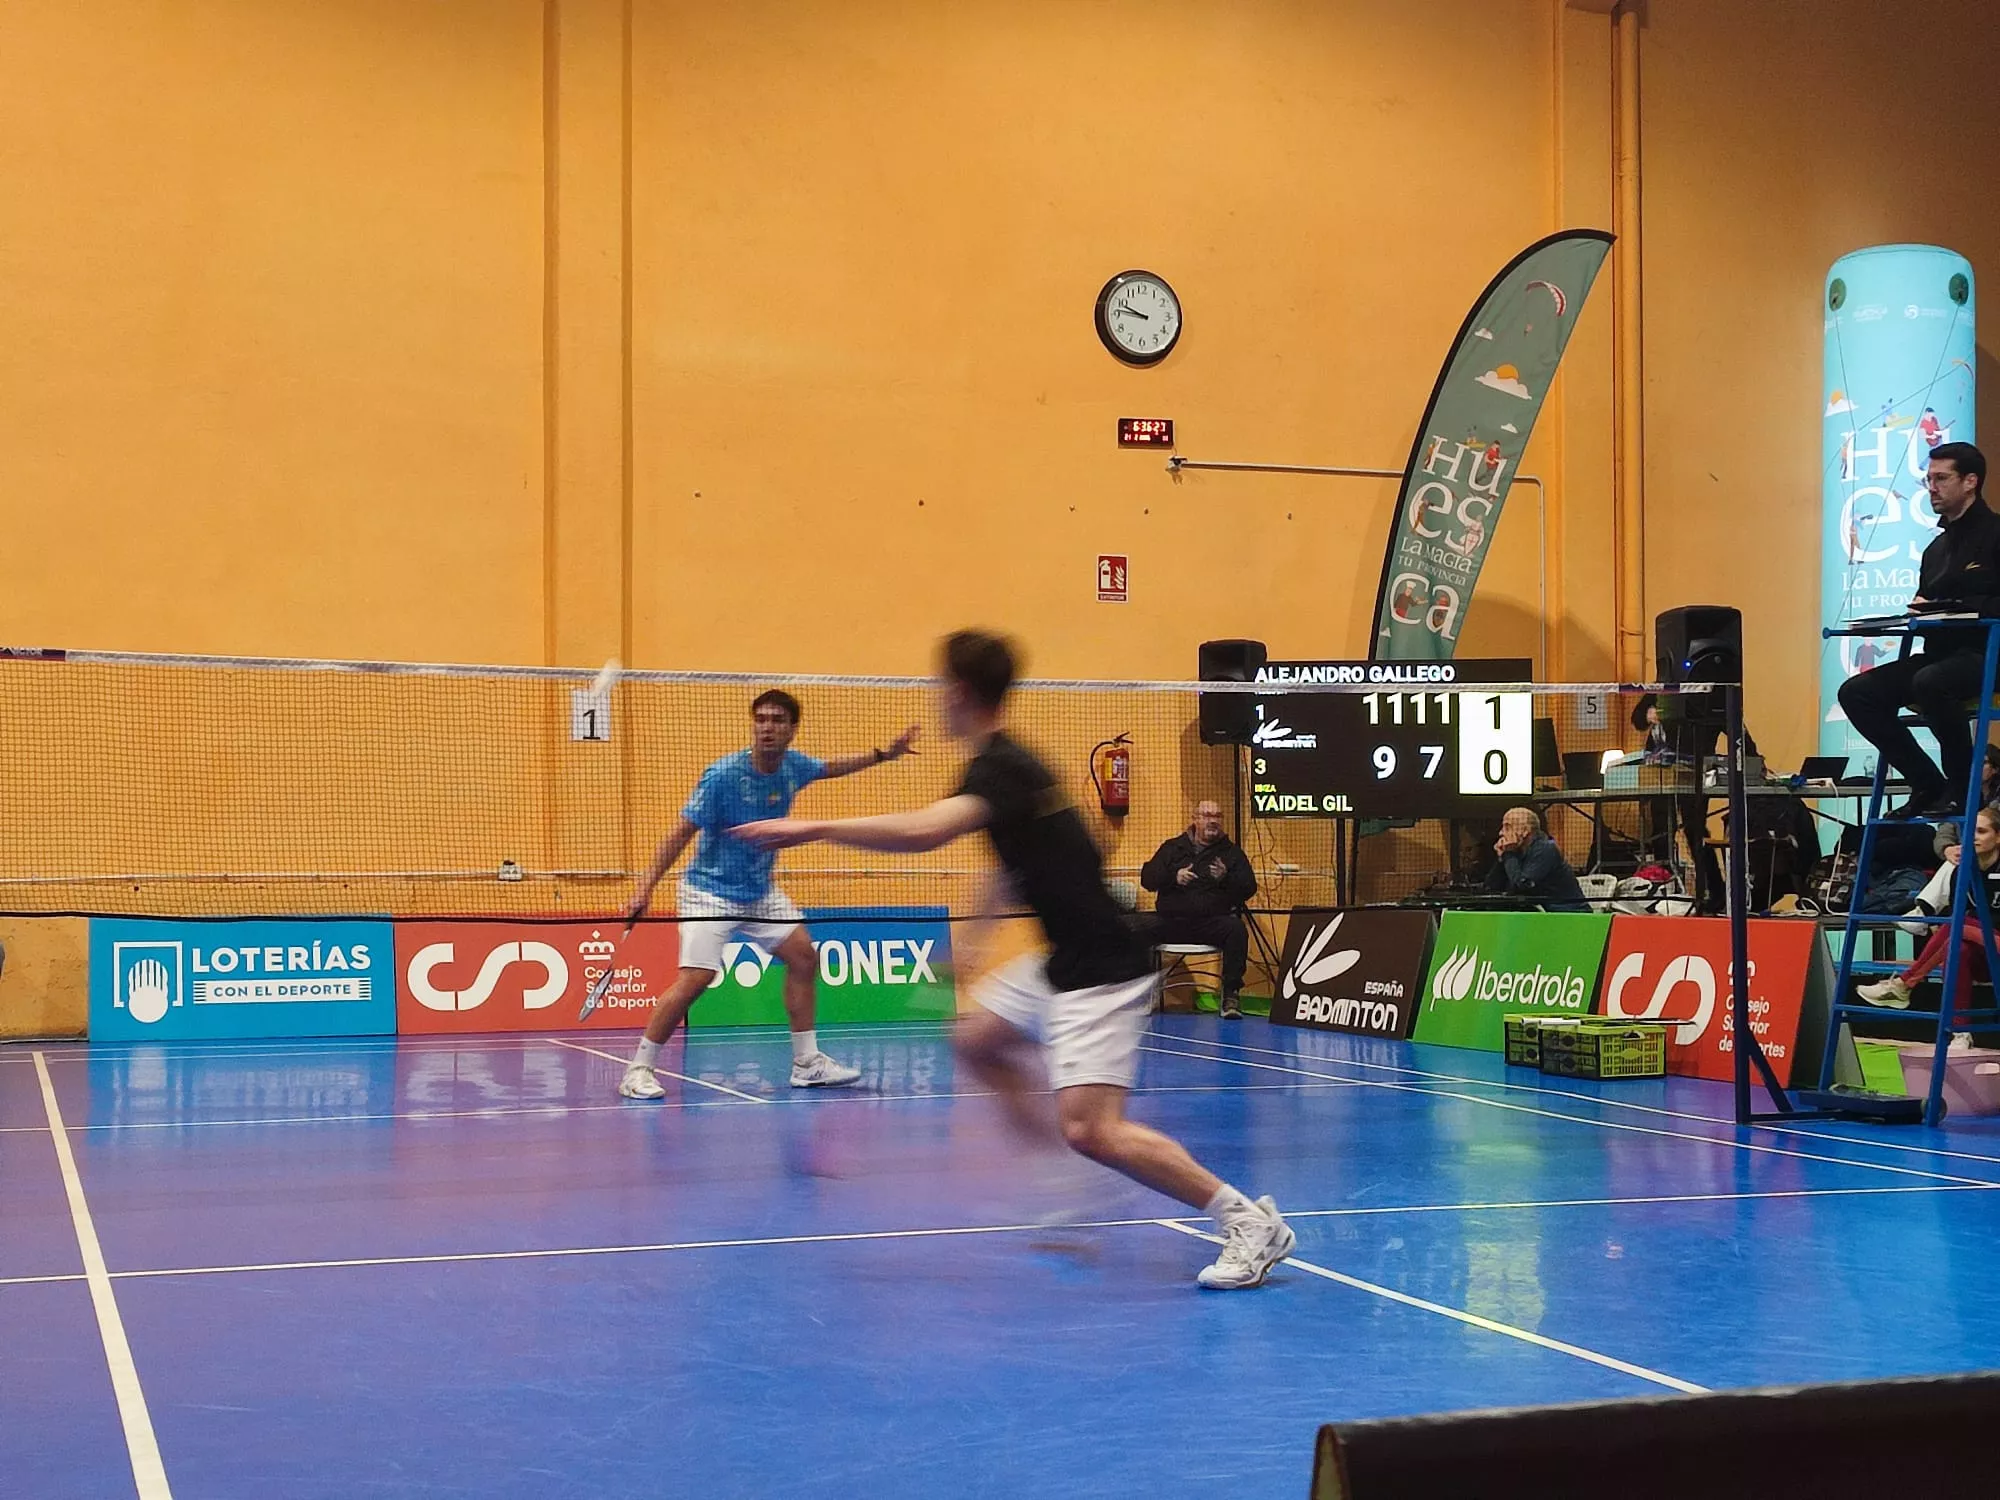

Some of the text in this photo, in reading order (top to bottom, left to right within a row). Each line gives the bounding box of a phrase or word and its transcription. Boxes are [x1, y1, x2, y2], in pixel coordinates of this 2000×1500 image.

[1873, 568, 1920, 590] Ma
[1254, 665, 1455, 684] ALEJANDRO GALLEGO
[1255, 704, 1264, 720] 1
[1485, 695, 1500, 729] 1
[1587, 696, 1597, 714] 5
[583, 709, 600, 740] 1
[1254, 758, 1266, 775] 3
[1372, 745, 1444, 780] 9 7
[1483, 749, 1508, 785] 0
[1254, 795, 1353, 812] YAIDEL GIL
[192, 940, 371, 973] LOTERÍAS
[584, 965, 643, 981] Cosejo
[213, 984, 351, 997] CON EL DEPORTE
[585, 981, 647, 996] Sperior
[1364, 980, 1404, 998] ESPAÑA
[1474, 961, 1585, 1008] Iberdrola
[608, 996, 658, 1010] Deport
[1295, 994, 1398, 1031] BADMINTON
[1719, 1034, 1733, 1052] de
